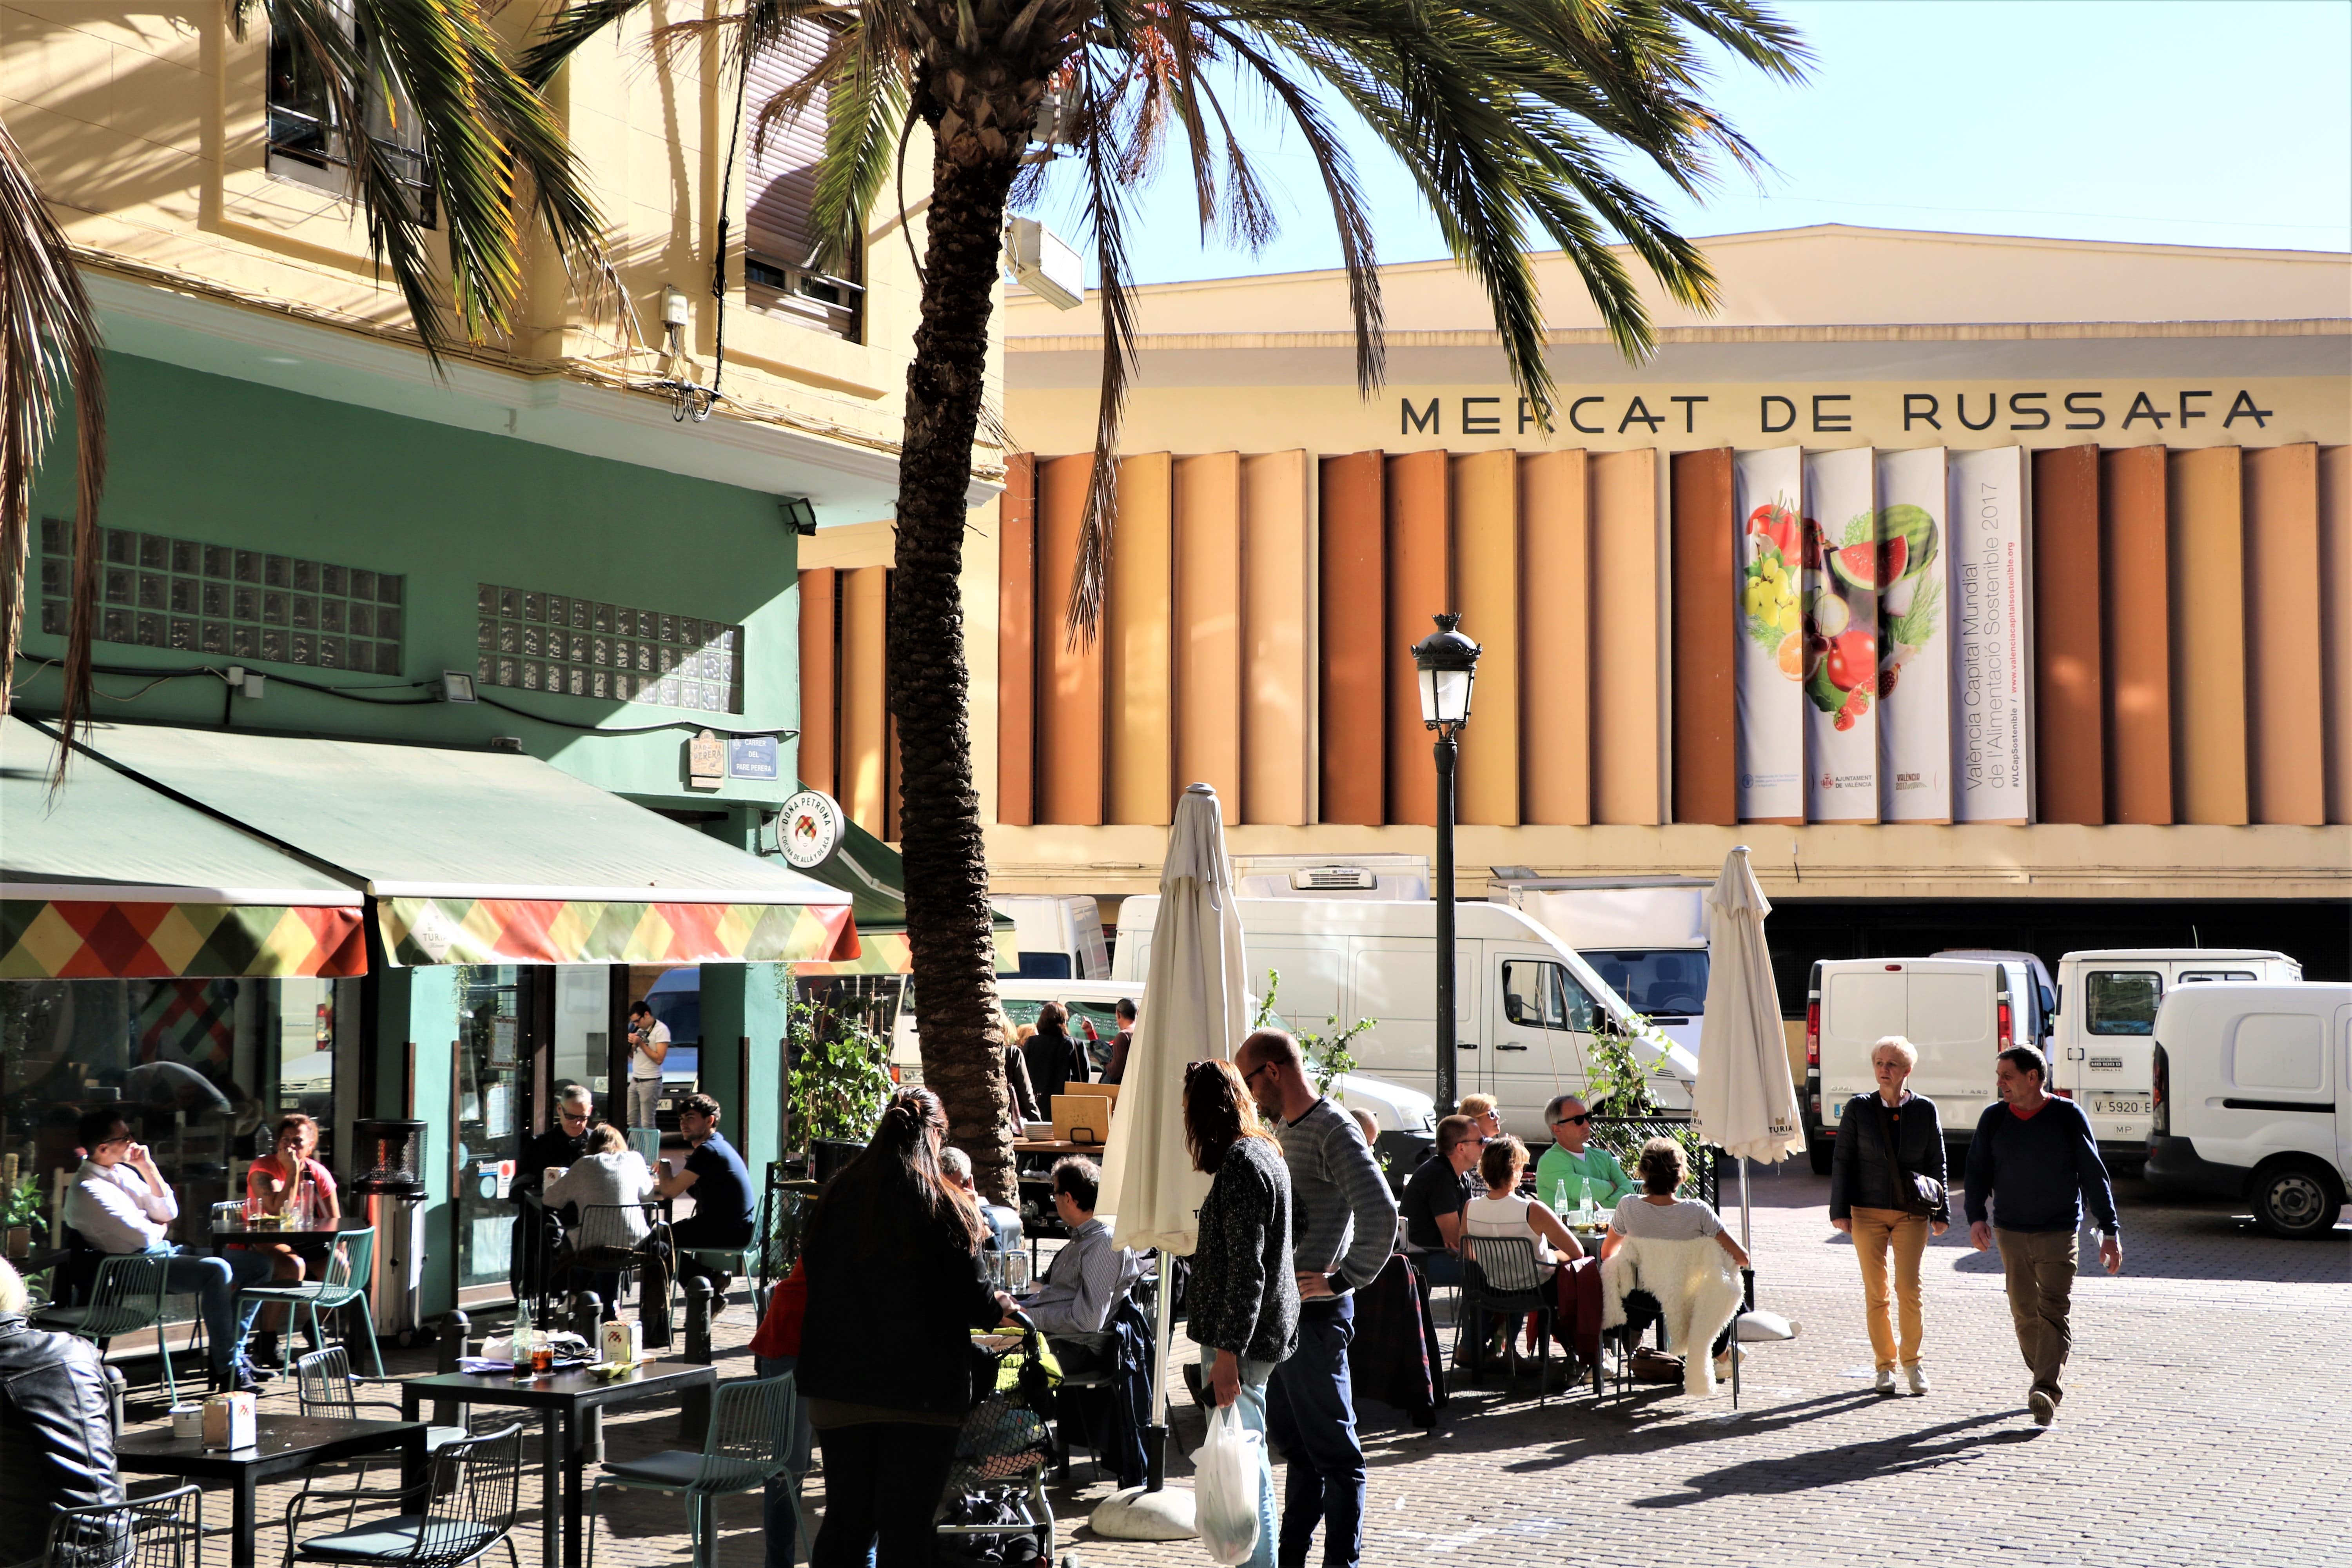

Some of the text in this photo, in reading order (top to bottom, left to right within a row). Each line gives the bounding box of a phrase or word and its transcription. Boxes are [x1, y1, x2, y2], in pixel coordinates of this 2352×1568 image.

[1401, 390, 2273, 435] MERCAT DE RUSSAFA
[1982, 483, 2004, 788] de l'Alimentació Sostenible 2017
[2007, 542, 2017, 693] www.valenciacapitalsostenible.org
[1962, 563, 1983, 791] València Capital Mundial
[694, 750, 722, 760] PERERA
[2010, 708, 2020, 788] #VLCapSostenible
[782, 797, 831, 826] DOÑA PETRONA
[782, 836, 792, 857] COCINA
[817, 848, 824, 856] DE
